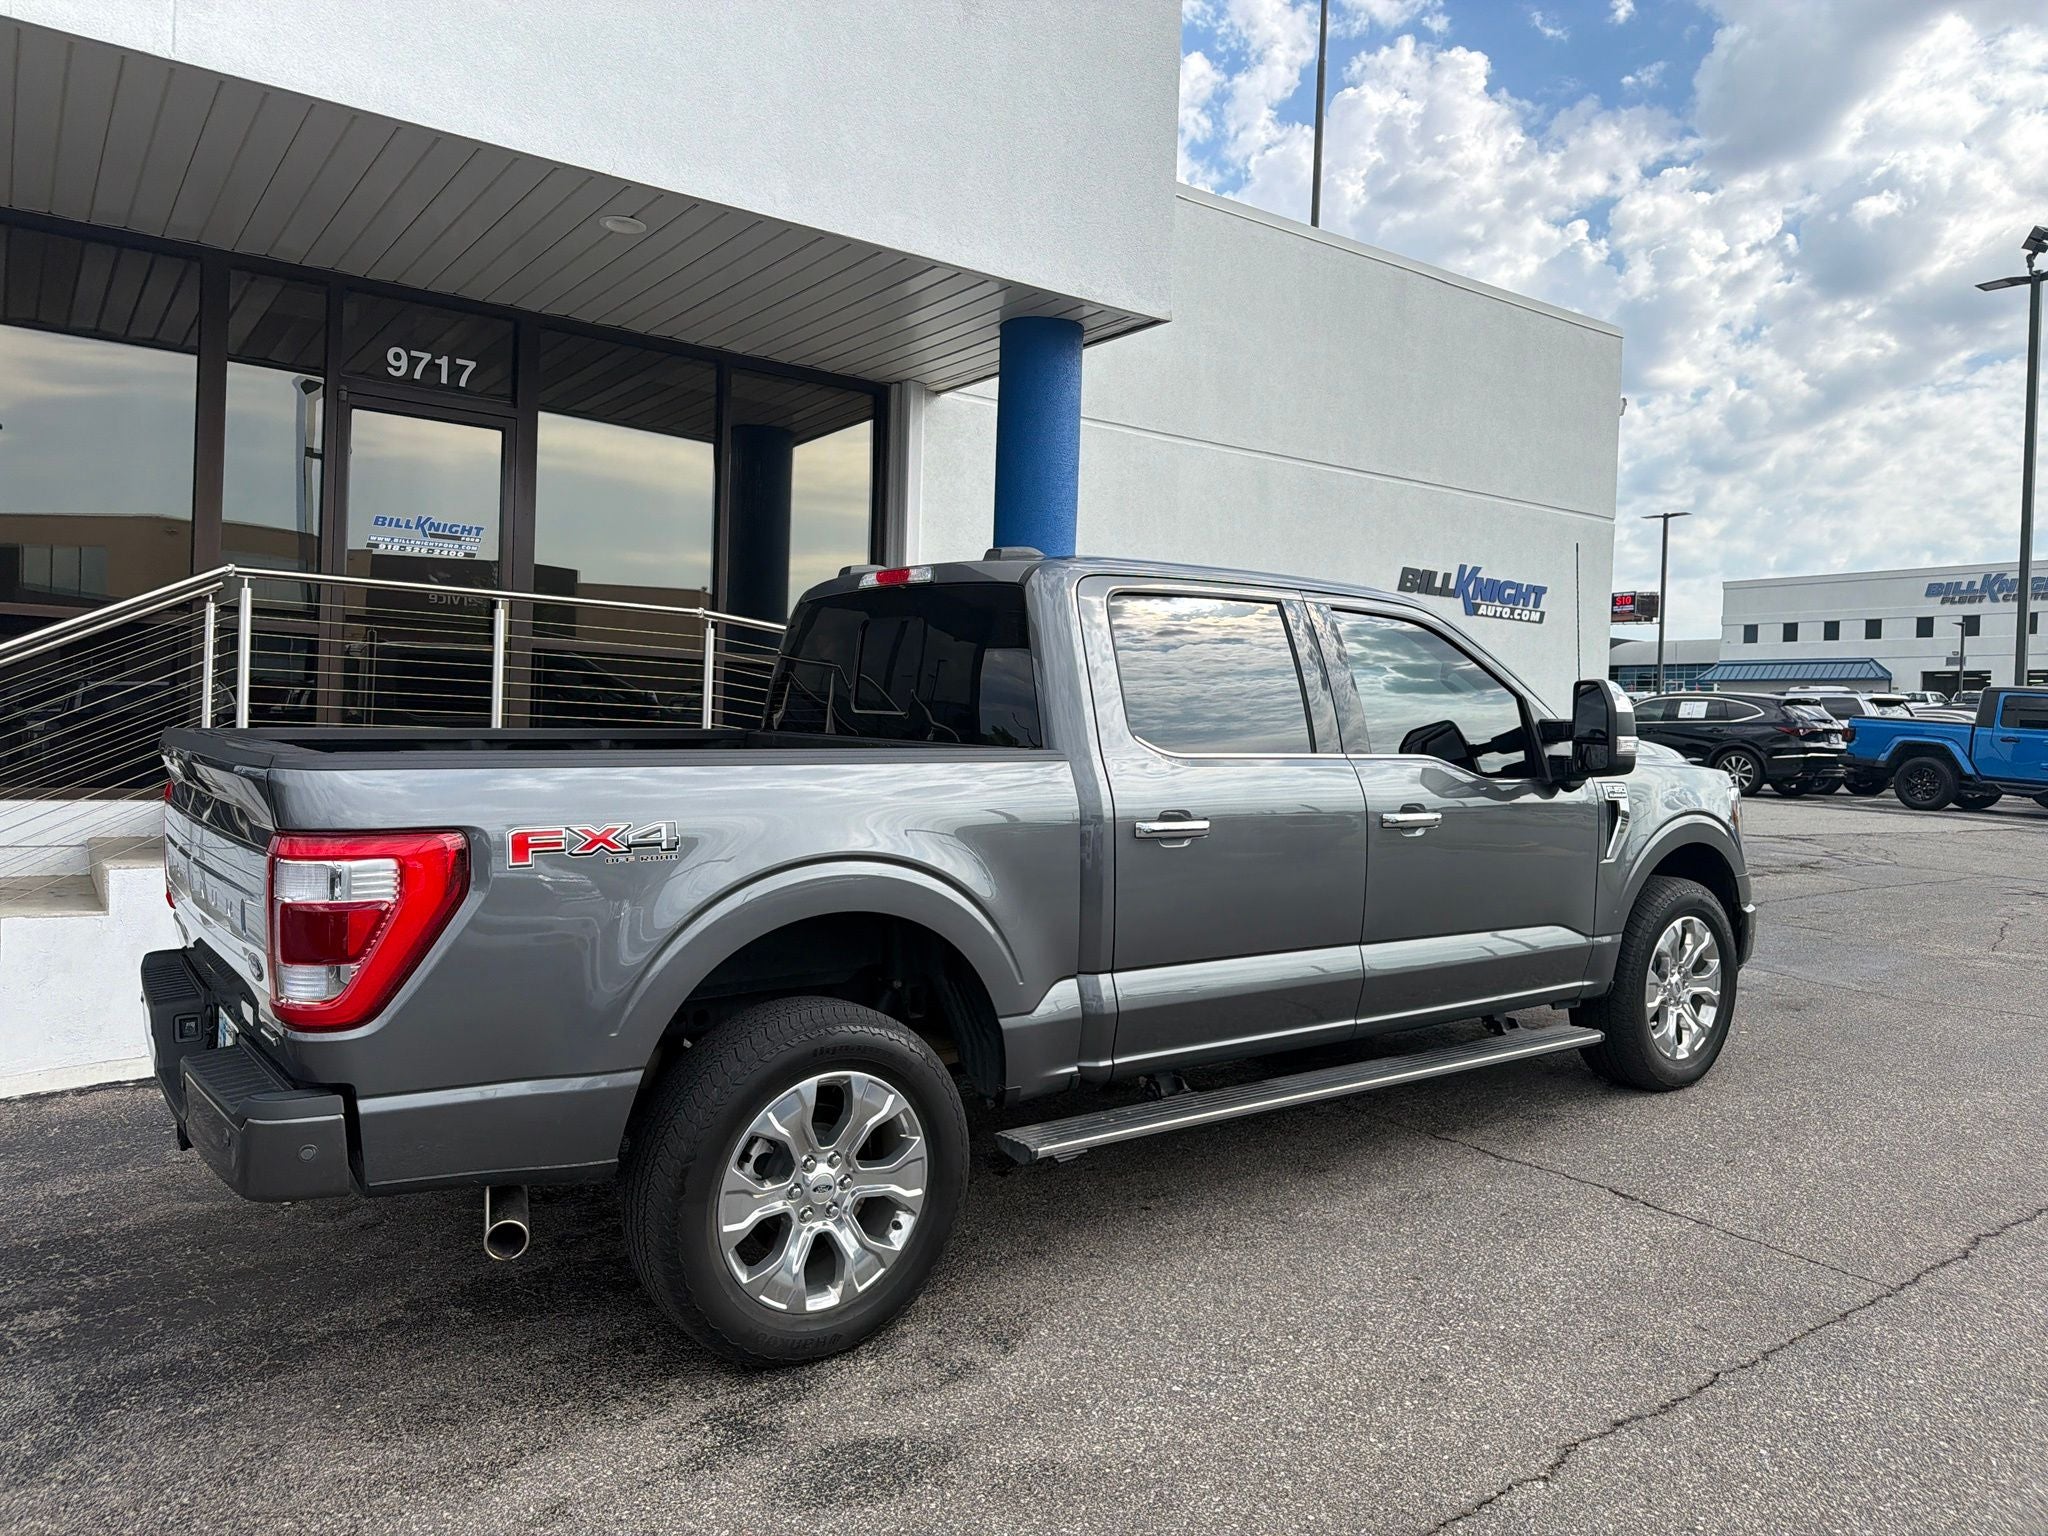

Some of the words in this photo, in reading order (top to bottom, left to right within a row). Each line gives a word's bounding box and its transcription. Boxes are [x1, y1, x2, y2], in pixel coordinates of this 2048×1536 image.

[386, 347, 477, 388] 9717
[1940, 595, 1986, 605] FLEET
[1477, 605, 1541, 622] AUTO.COM
[506, 821, 680, 870] FX4
[604, 857, 636, 865] OFF
[639, 854, 679, 863] ROAD
